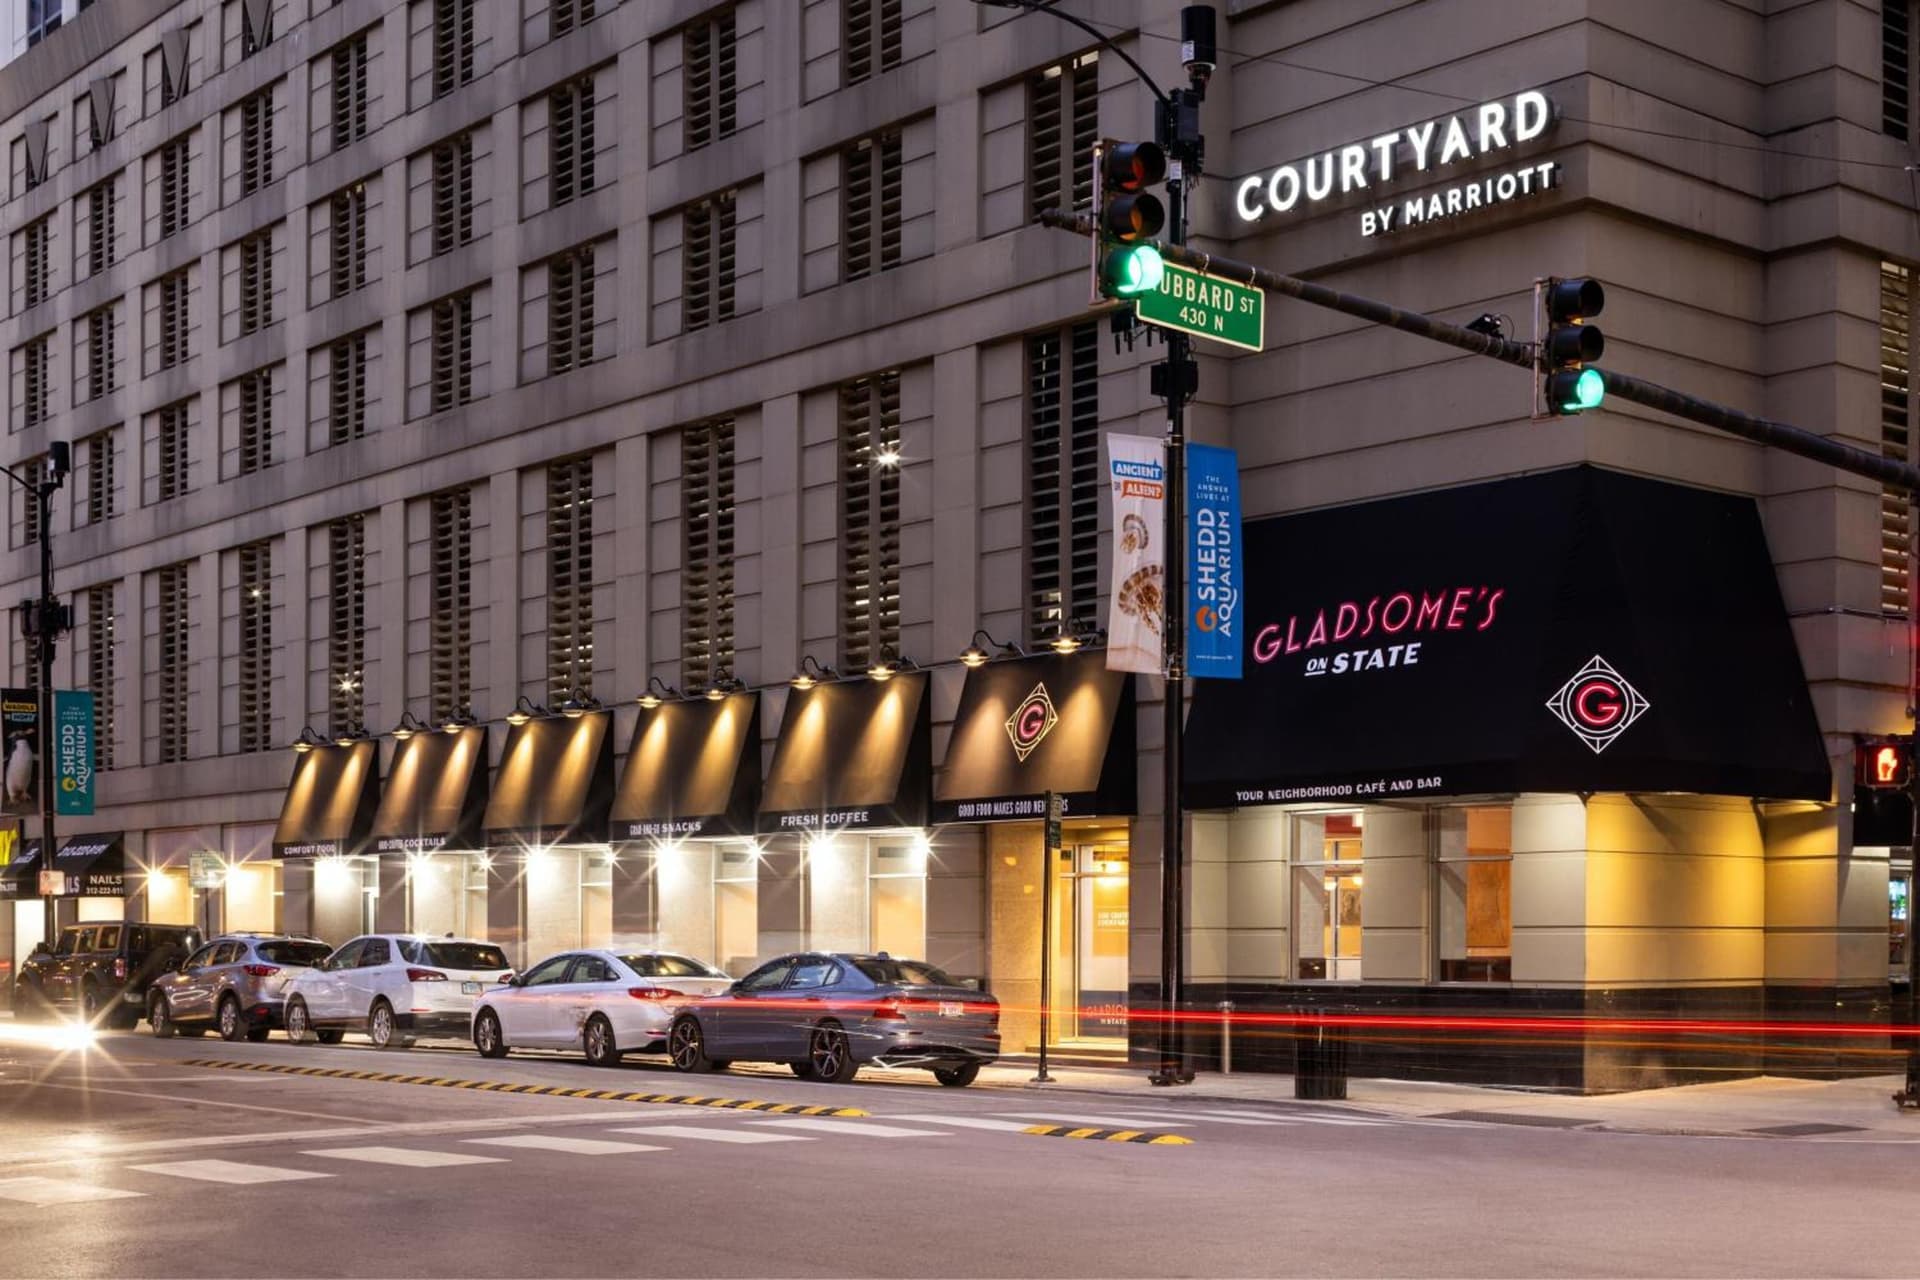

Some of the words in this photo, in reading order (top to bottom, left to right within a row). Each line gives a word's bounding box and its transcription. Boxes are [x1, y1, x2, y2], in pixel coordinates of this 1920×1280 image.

[1236, 90, 1549, 222] COURTYARD
[1361, 206, 1394, 237] BY
[1405, 161, 1555, 225] MARRIOTT
[1161, 271, 1234, 313] UBBARD
[1240, 296, 1255, 315] ST
[1179, 306, 1207, 327] 430
[1214, 315, 1224, 332] N
[1115, 463, 1161, 479] ANCIENT
[1126, 482, 1162, 498] ALIEN?
[1197, 507, 1217, 601] SHEDD
[1217, 511, 1238, 638] AQUARIUM
[1253, 586, 1505, 664] GLADSOME'S
[1305, 656, 1329, 673] ON
[1331, 642, 1422, 674] STATE
[1575, 680, 1622, 726] G
[1018, 703, 1045, 739] G
[62, 724, 76, 775] SHEDD
[76, 725, 92, 795] AQUARIUM
[1236, 791, 1264, 801] YOUR
[1268, 785, 1353, 800] NEIGHBORHOOD
[1356, 779, 1386, 794] CAFÉ
[1390, 780, 1414, 792] AND
[1417, 776, 1443, 788] BAR
[781, 813, 819, 827] FRESH
[823, 811, 869, 824] COFFEE
[958, 804, 975, 817] GOOD
[976, 803, 993, 816] FOOD
[993, 801, 1014, 815] MAKES
[1015, 800, 1032, 814] GOOD
[404, 837, 446, 849] COCKTAILS
[661, 821, 702, 833] SNACKS
[89, 874, 123, 885] NAILS
